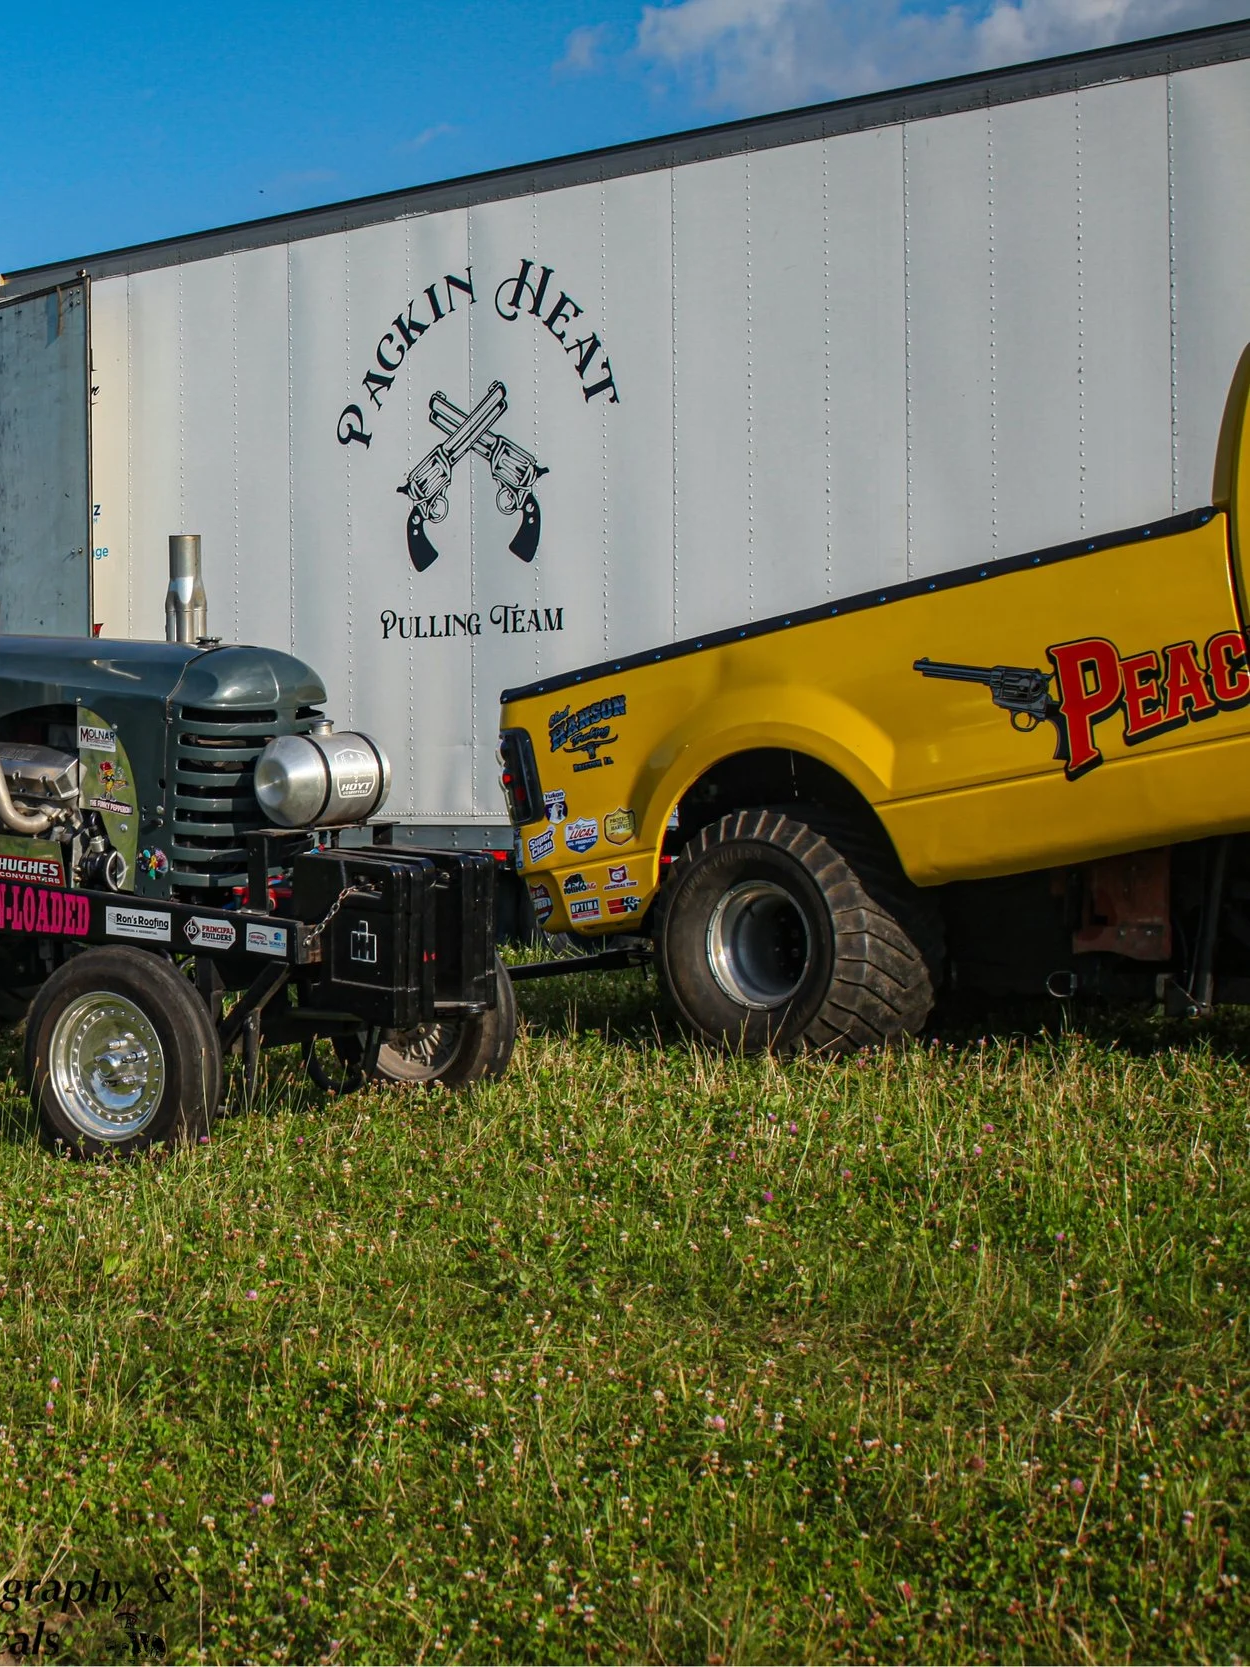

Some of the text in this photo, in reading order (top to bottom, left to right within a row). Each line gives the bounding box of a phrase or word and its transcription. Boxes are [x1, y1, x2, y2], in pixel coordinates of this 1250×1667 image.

[336, 258, 620, 450] PACKIN HEAT
[380, 603, 564, 640] PULLING TEAM
[548, 694, 627, 753] HANSON
[80, 727, 115, 742] MOLNAR
[341, 781, 372, 791] HOYT
[544, 791, 564, 800] Yukon
[530, 831, 552, 849] Super
[569, 826, 596, 840] LUCAS
[532, 841, 553, 858] Clean
[571, 900, 599, 914] OPTIMA
[116, 913, 169, 930] Ron's Roofing
[201, 924, 234, 935] PRINCIPAL
[201, 931, 232, 942] BUILDERS
